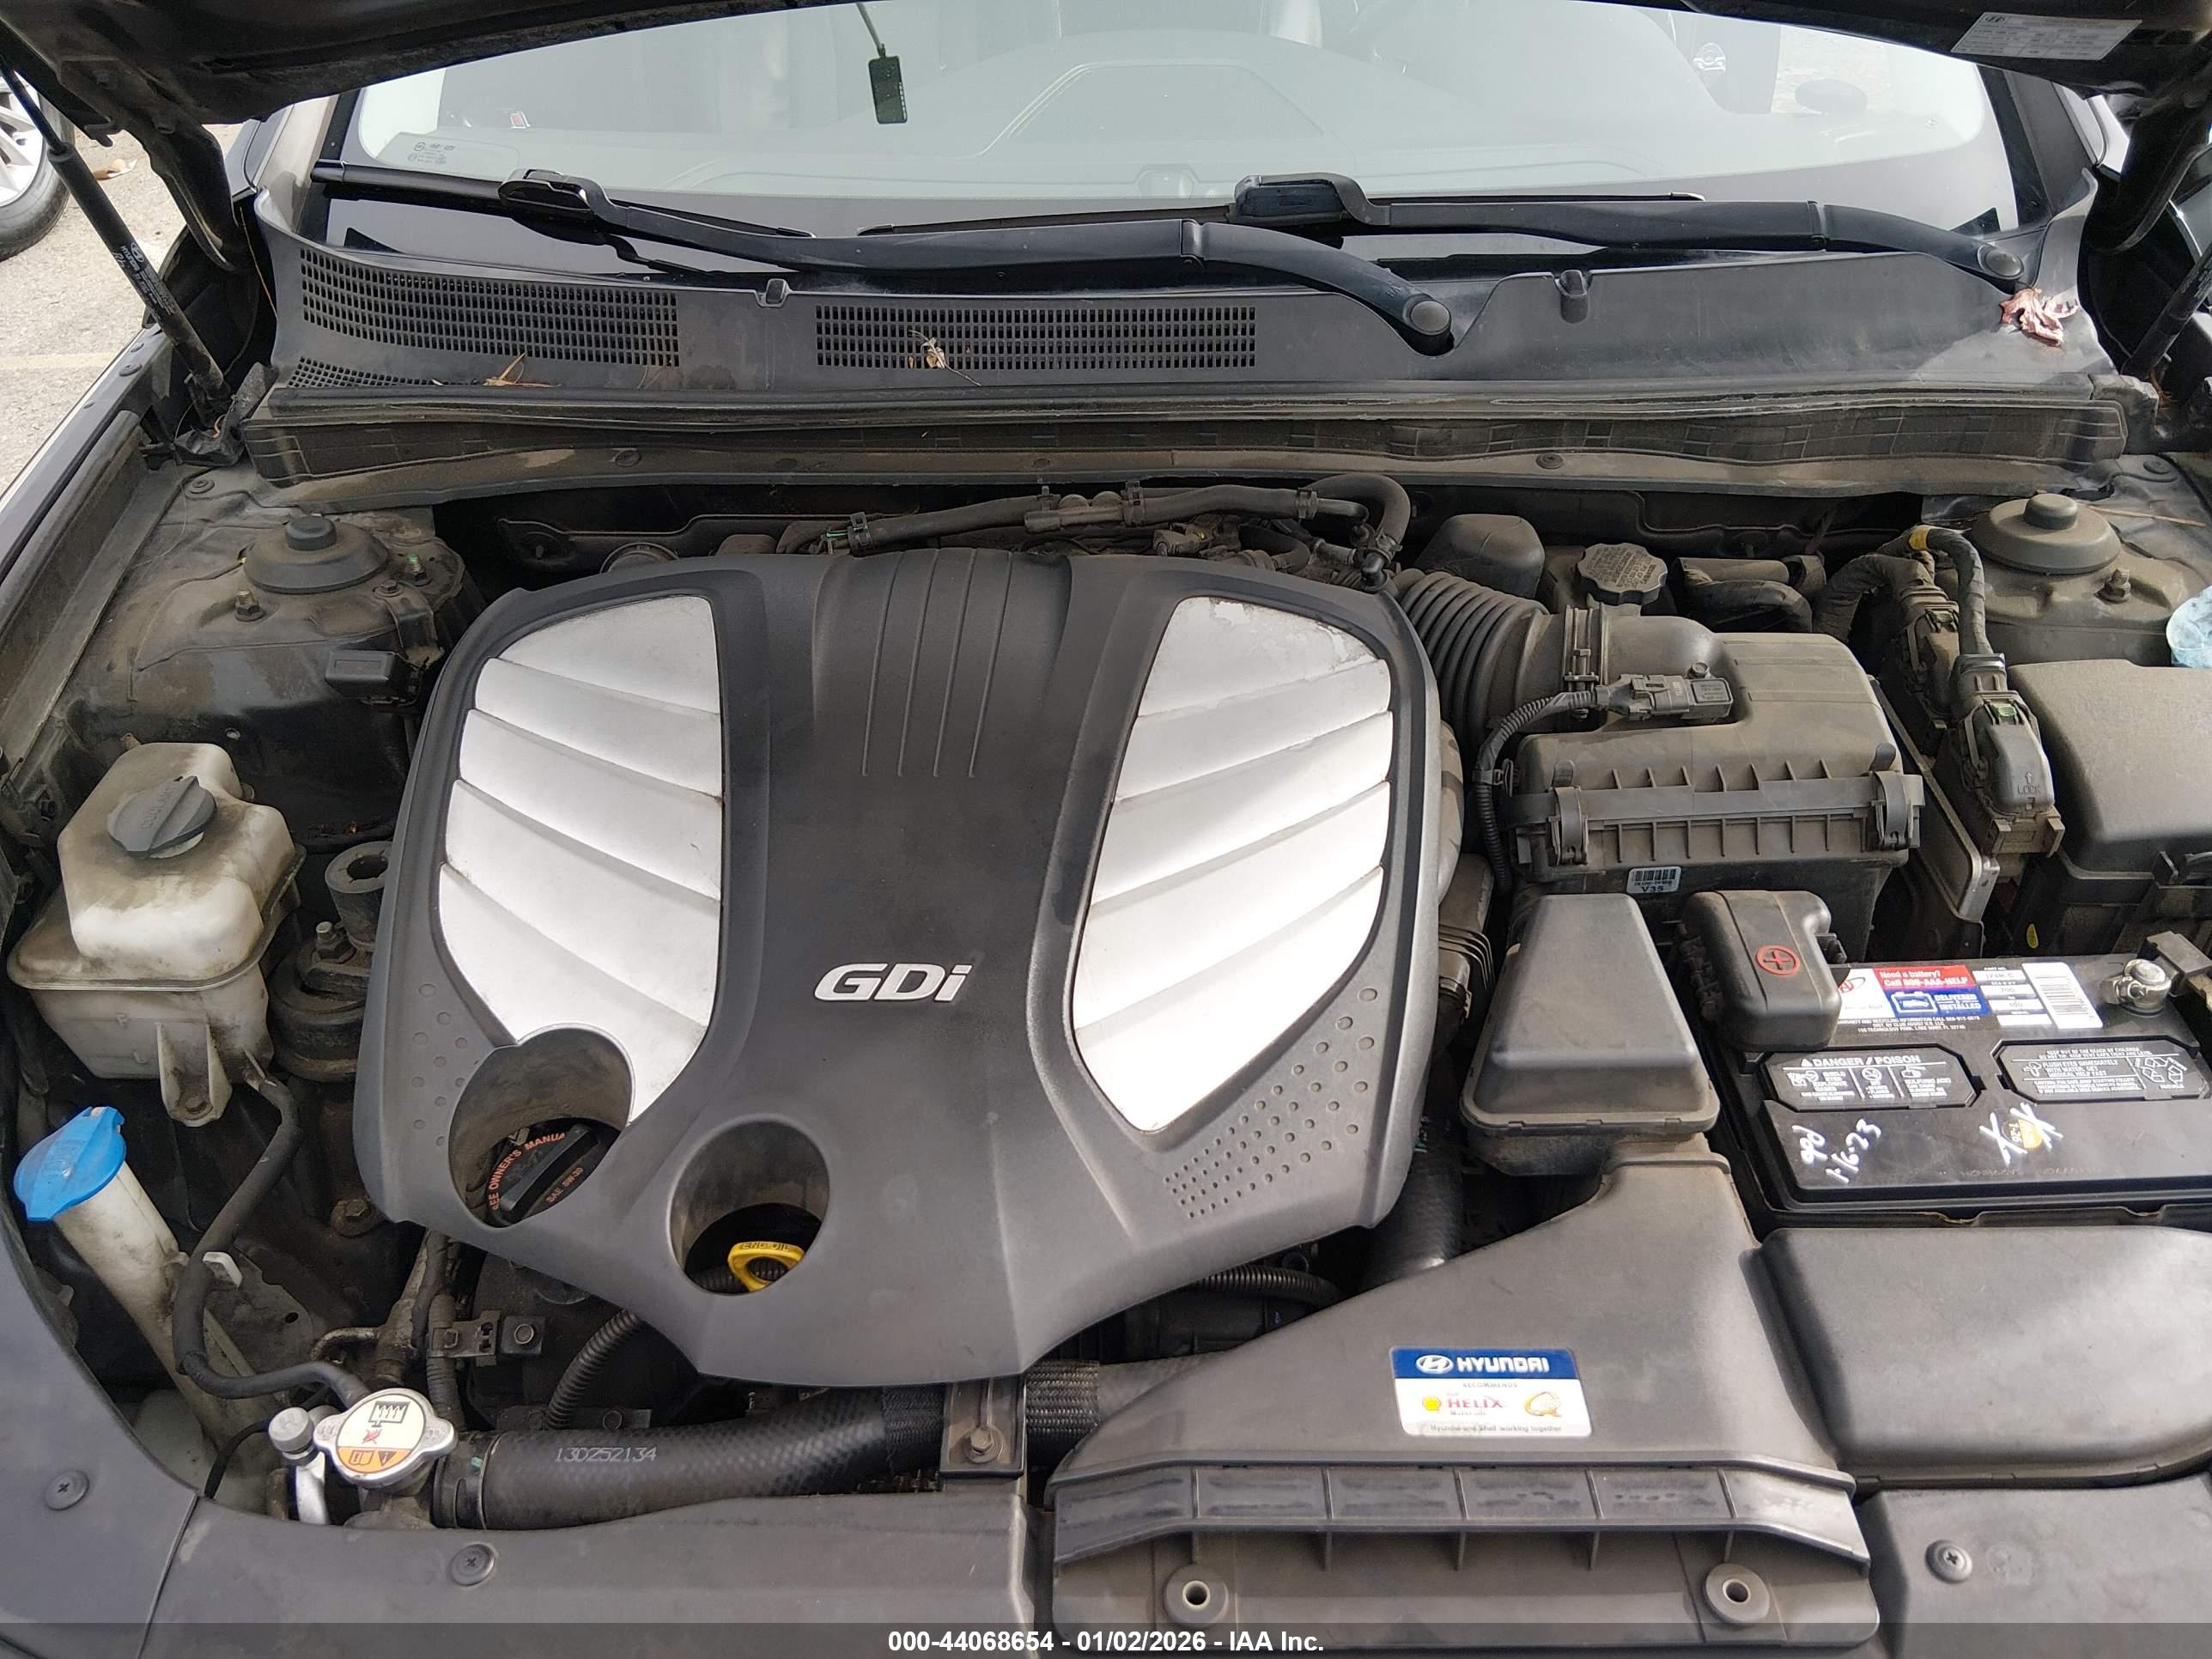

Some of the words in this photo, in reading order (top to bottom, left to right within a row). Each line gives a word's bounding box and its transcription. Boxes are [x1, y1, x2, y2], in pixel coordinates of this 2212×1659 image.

[2016, 783, 2041, 795] LOCK
[1908, 969, 1941, 979] battery?
[815, 963, 973, 1002] GDi
[1812, 1057, 1864, 1066] DANGER
[1874, 1054, 1922, 1065] POISON
[488, 1149, 522, 1191] OWNER'S
[1456, 1356, 1550, 1373] HYUNDAI
[1448, 1397, 1504, 1408] HELIX
